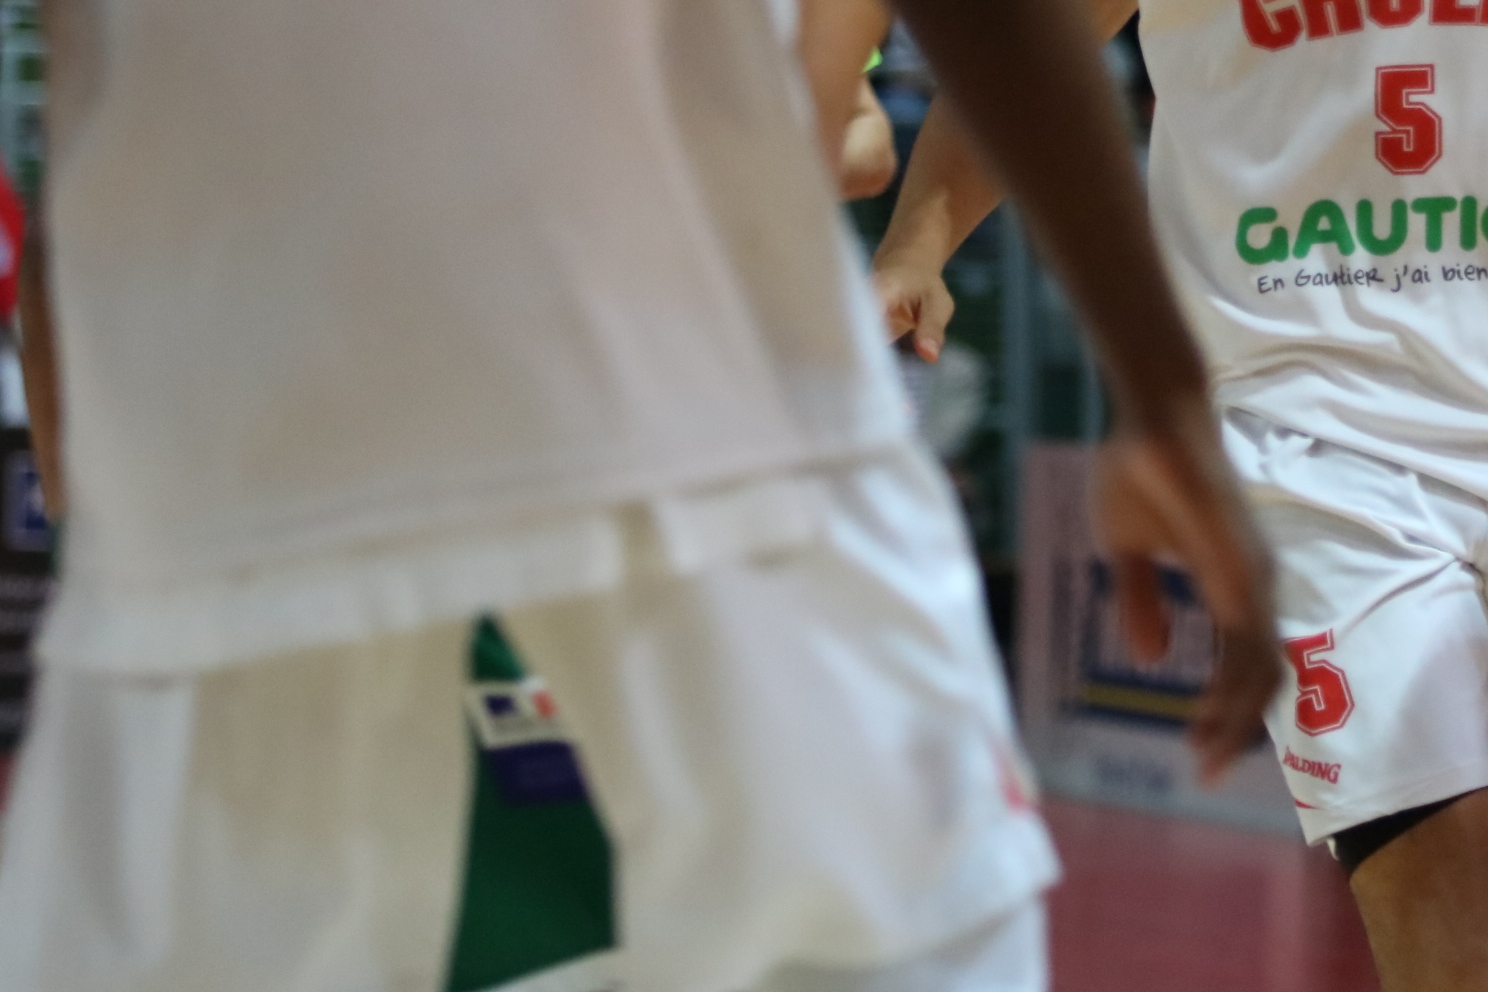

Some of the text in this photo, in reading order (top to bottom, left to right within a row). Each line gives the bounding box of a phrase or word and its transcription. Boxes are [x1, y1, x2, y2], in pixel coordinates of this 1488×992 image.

[1375, 64, 1442, 175] 5
[1257, 271, 1285, 294] En
[1391, 264, 1431, 292] j'ai
[1442, 261, 1488, 282] bien
[1283, 628, 1355, 737] 5
